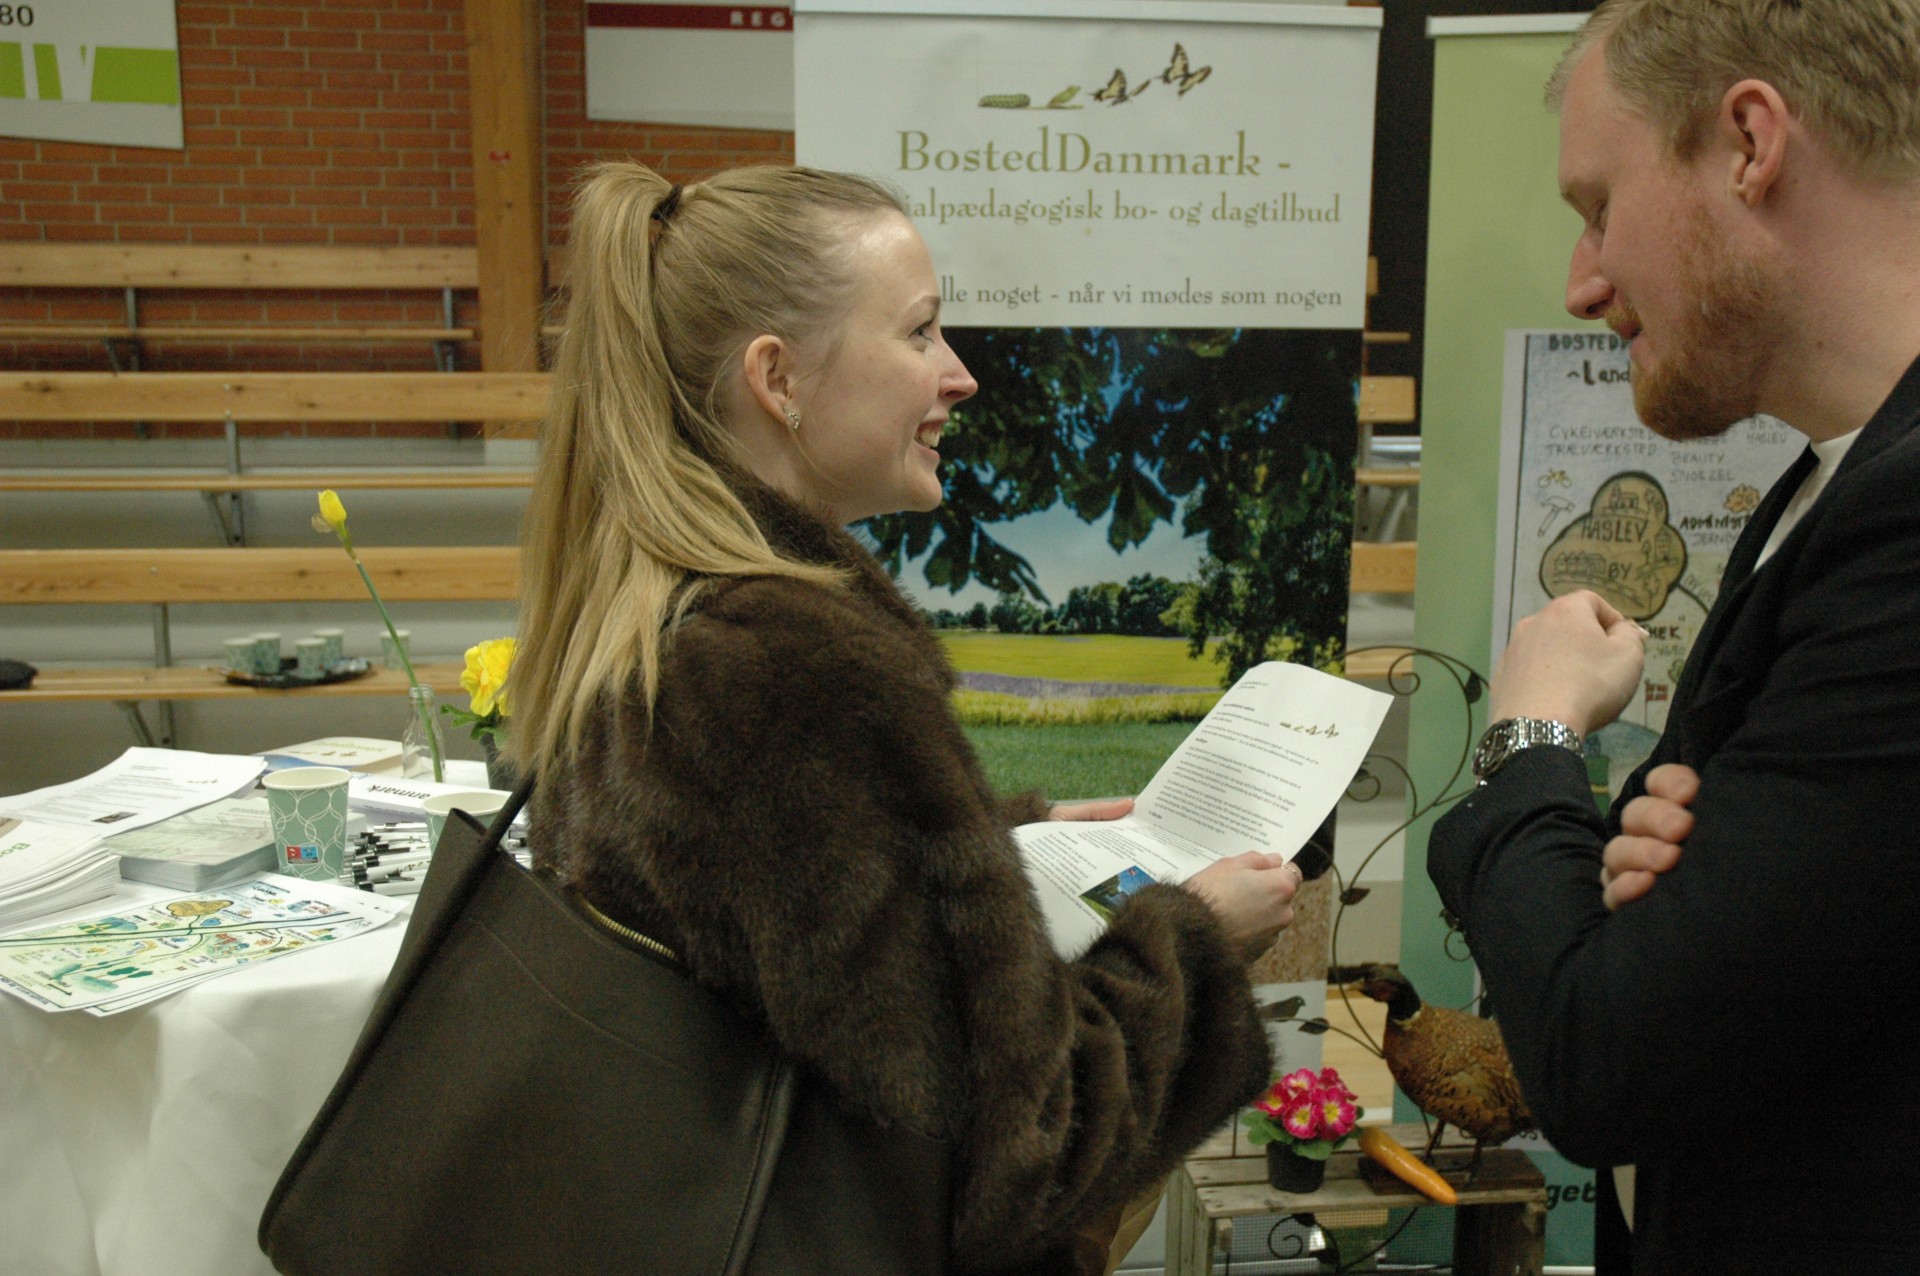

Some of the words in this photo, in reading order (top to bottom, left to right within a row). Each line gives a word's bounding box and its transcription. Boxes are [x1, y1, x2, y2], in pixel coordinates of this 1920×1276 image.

[897, 126, 1261, 177] BostedDanmark
[1114, 189, 1158, 220] bo-
[1168, 202, 1203, 228] og
[1211, 191, 1341, 229] dagtilbud
[977, 284, 1042, 310] noget
[1068, 282, 1105, 304] når
[1112, 284, 1133, 304] vi
[1141, 277, 1214, 304] mødes
[1221, 290, 1266, 305] som
[1275, 290, 1343, 311] nogen
[1581, 519, 1649, 543] HASLEV
